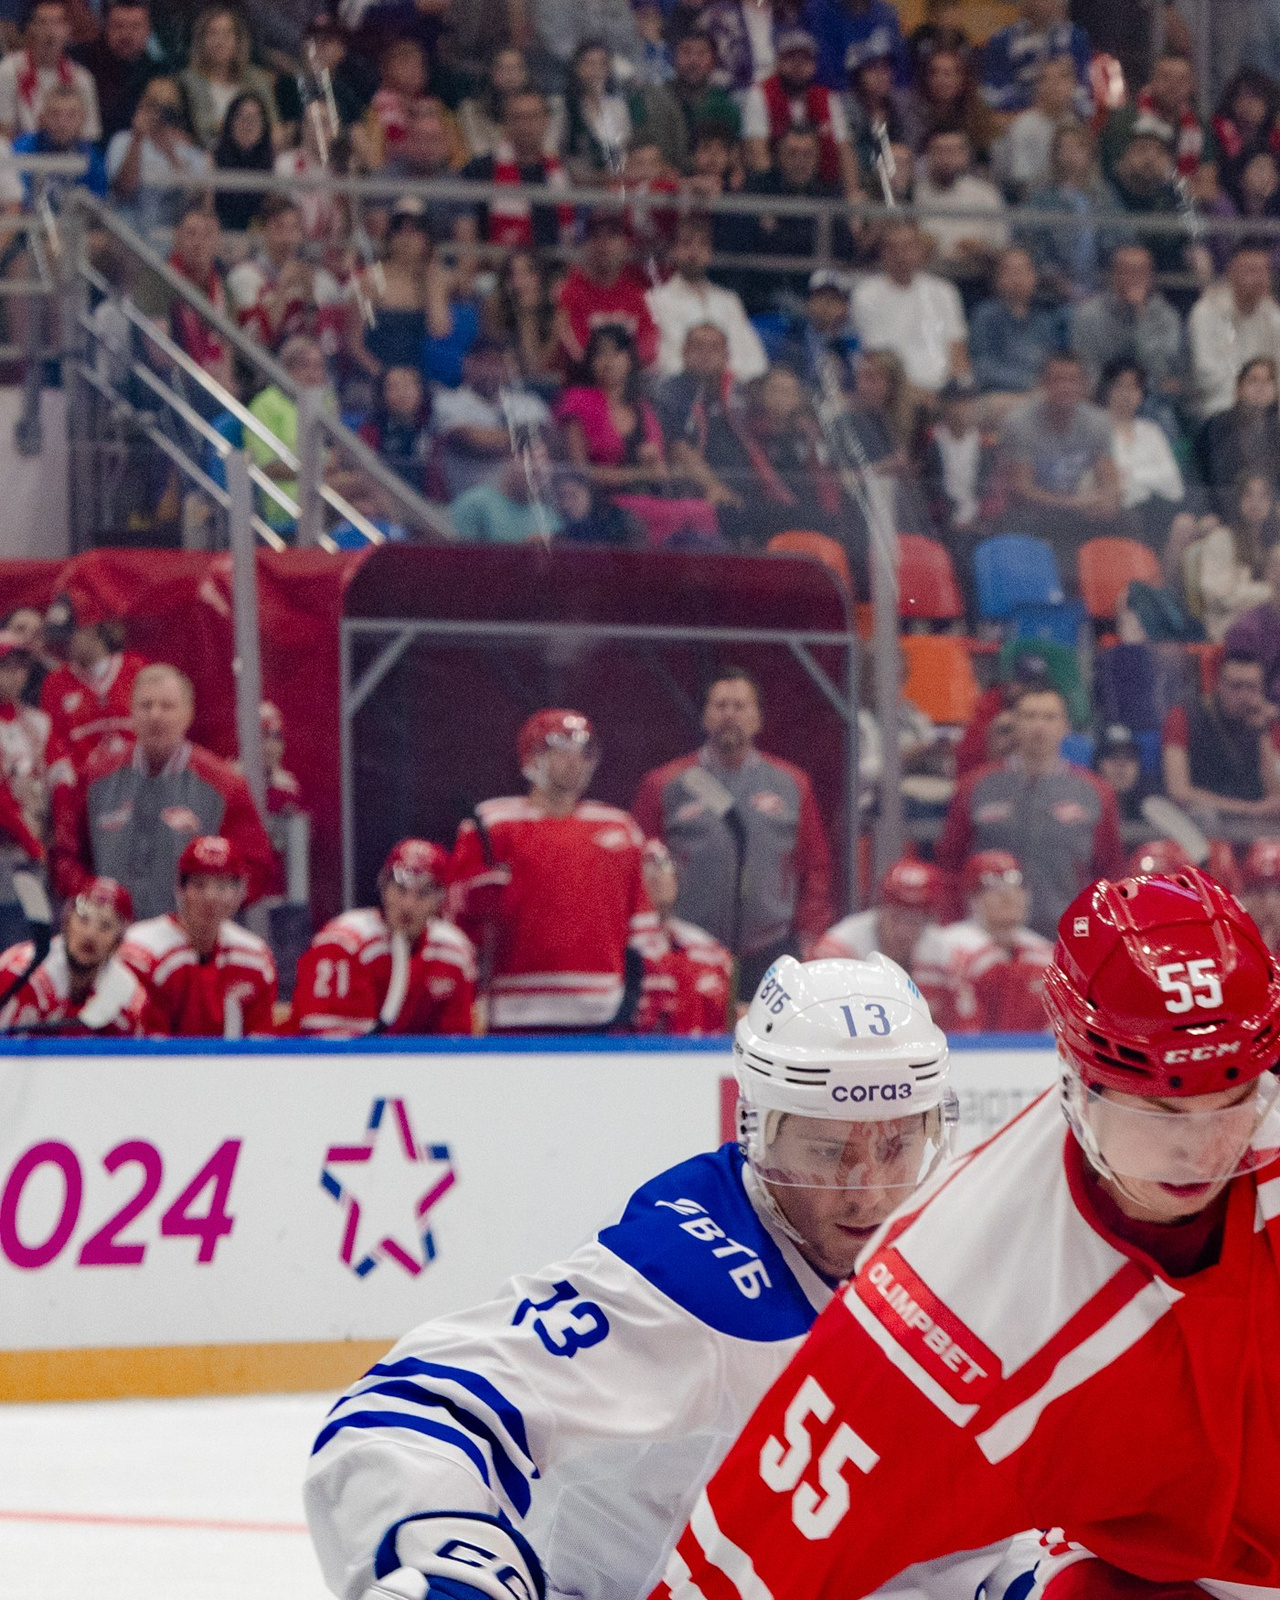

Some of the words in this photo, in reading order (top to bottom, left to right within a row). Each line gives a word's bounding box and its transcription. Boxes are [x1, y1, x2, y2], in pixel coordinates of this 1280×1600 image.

[313, 958, 350, 998] 21
[759, 978, 792, 1015] ВТБ
[1156, 958, 1223, 1014] 55
[839, 1003, 891, 1037] 13
[1163, 1041, 1241, 1064] CCM
[0, 1139, 242, 1268] 024
[679, 1216, 772, 1299] ВТБ
[511, 1280, 609, 1358] 13
[867, 1261, 989, 1384] OLIMPBET
[759, 1374, 881, 1540] 55
